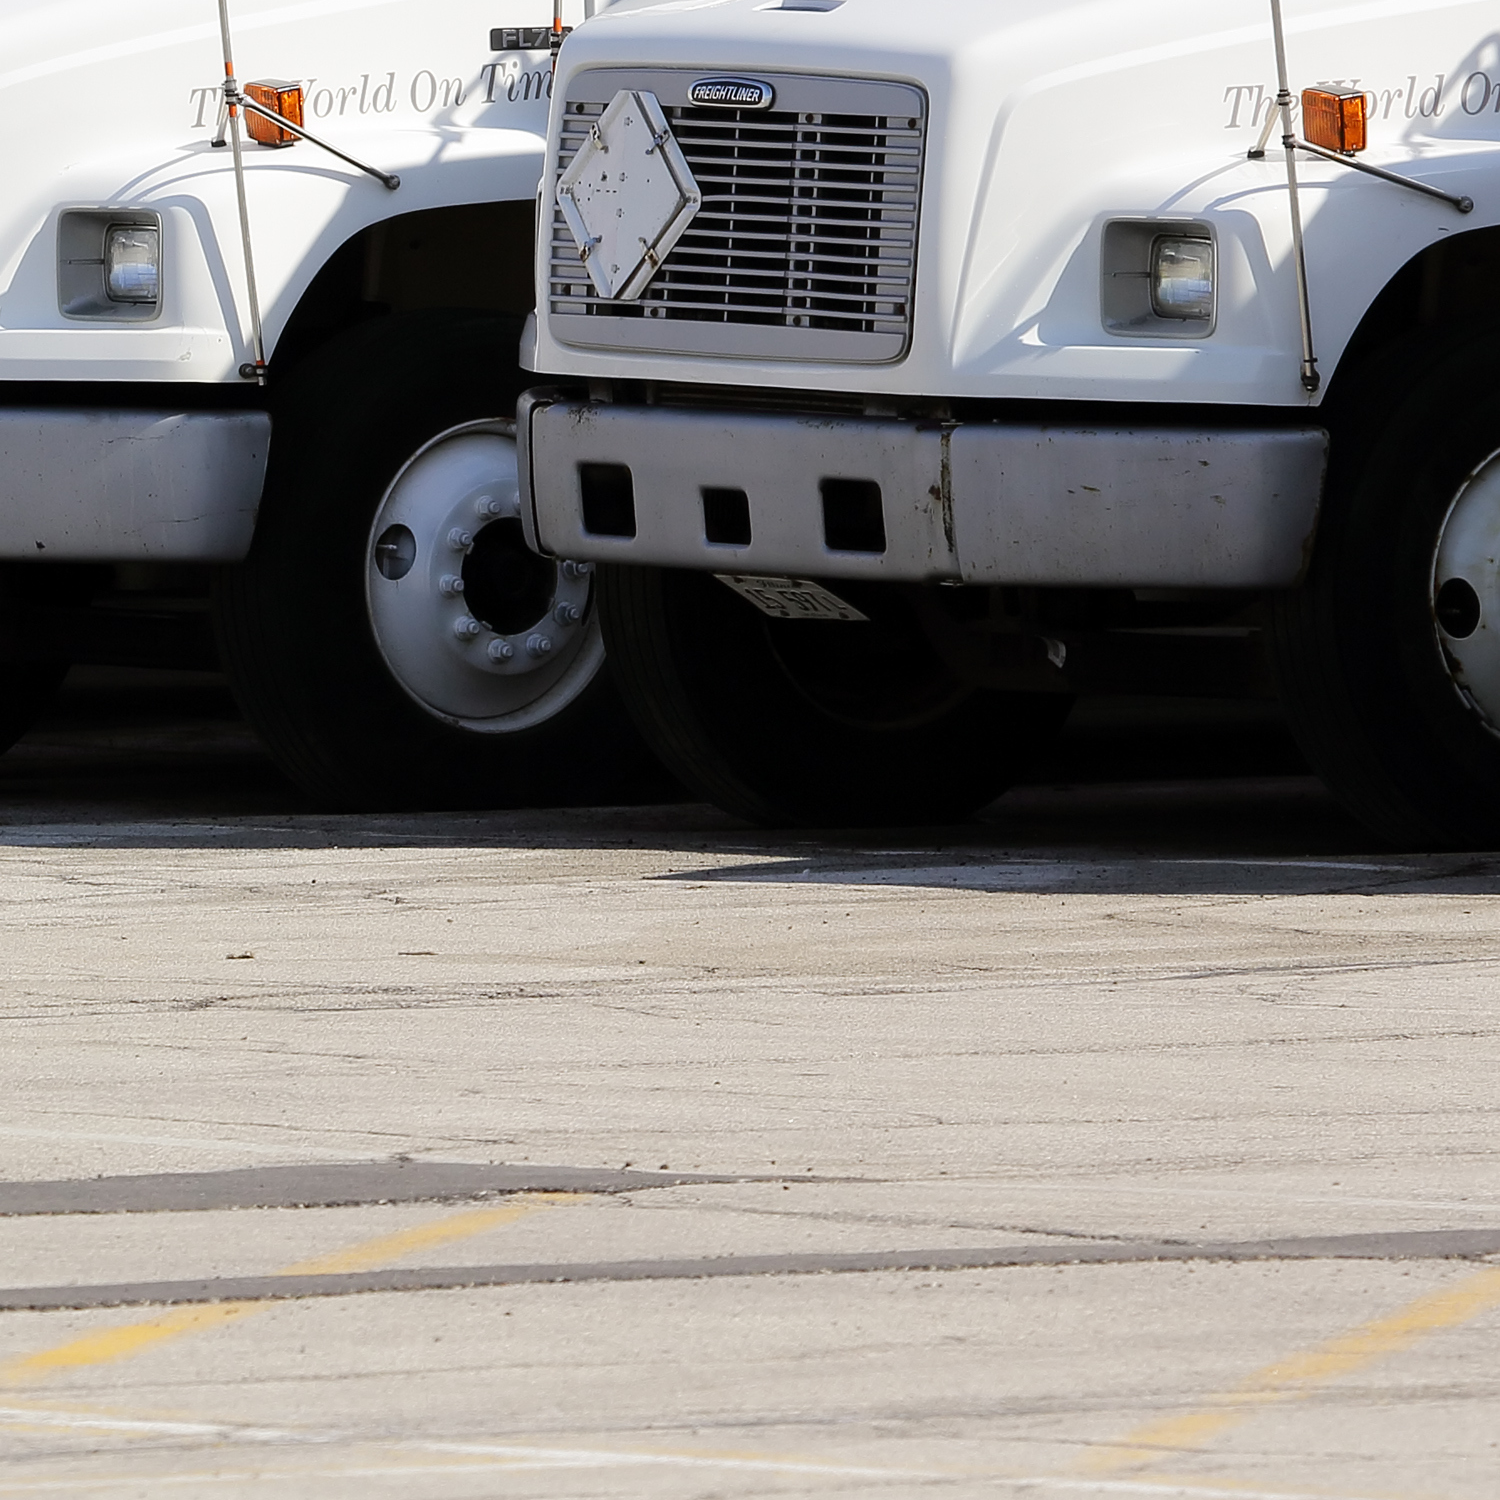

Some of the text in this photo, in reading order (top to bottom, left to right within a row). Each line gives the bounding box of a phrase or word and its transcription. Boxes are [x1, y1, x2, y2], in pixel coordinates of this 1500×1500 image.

[502, 28, 553, 48] FL7
[409, 70, 467, 113] On
[480, 61, 553, 104] Tim
[694, 85, 761, 102] FREIGHTLINER
